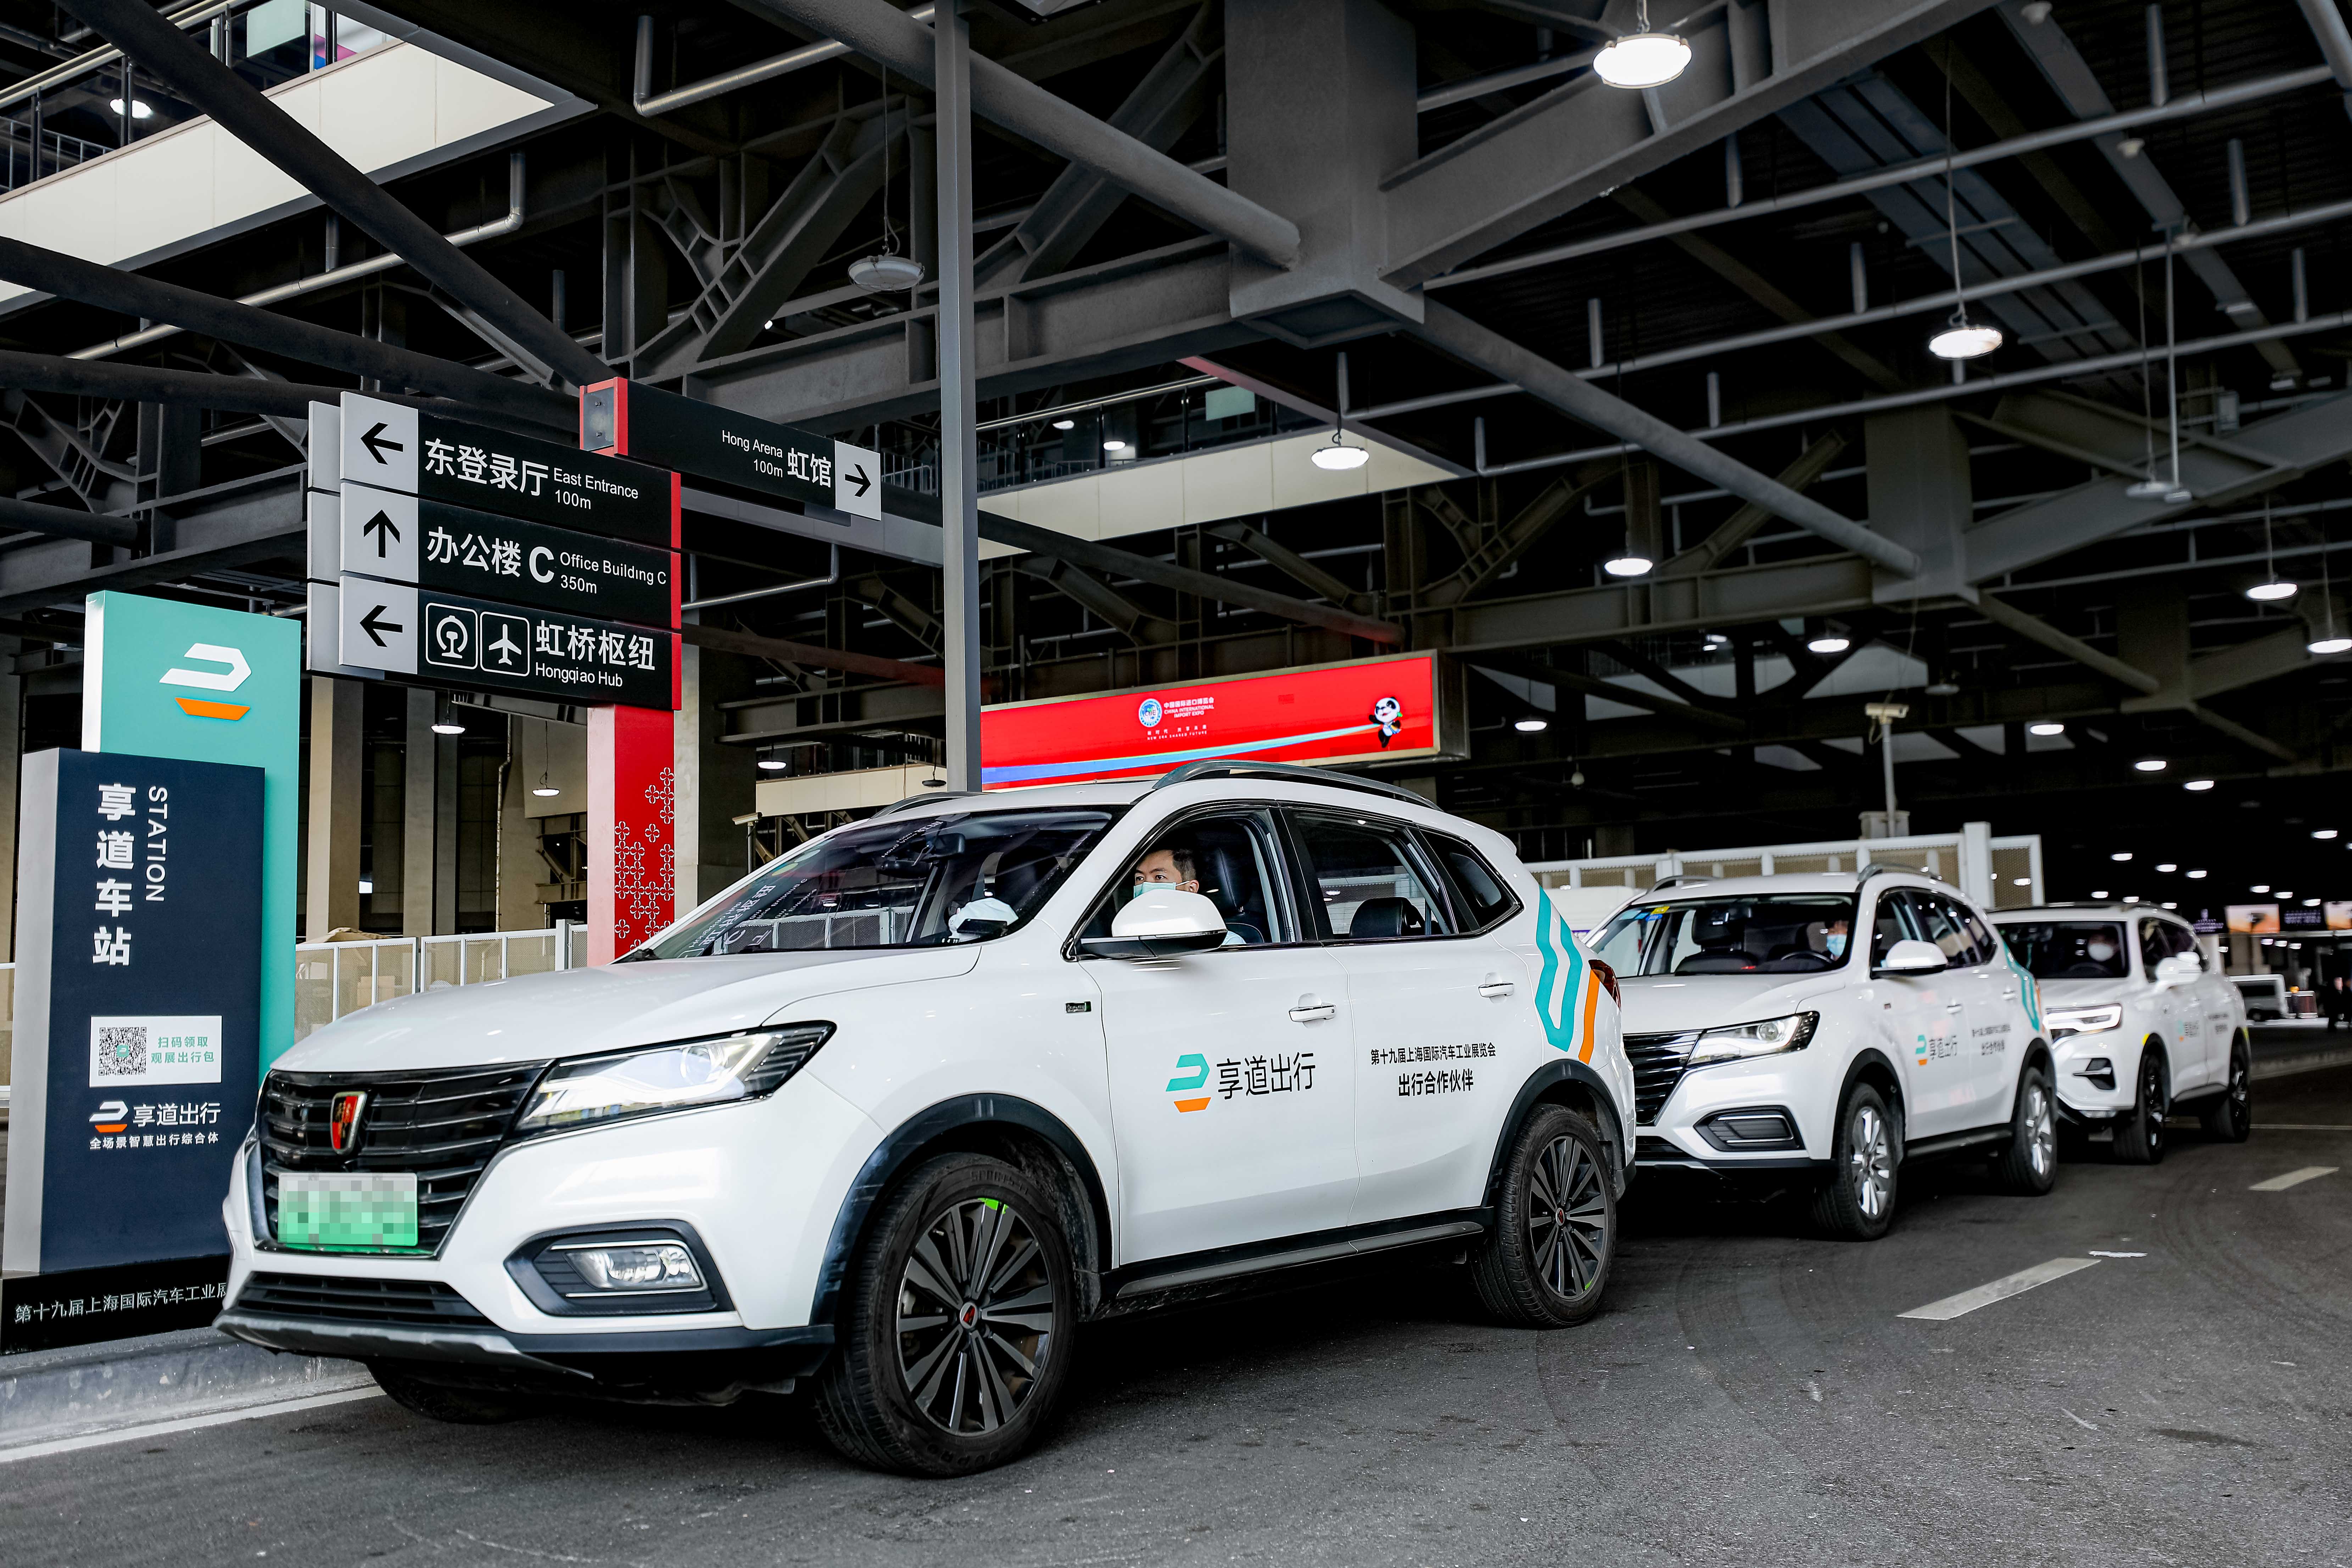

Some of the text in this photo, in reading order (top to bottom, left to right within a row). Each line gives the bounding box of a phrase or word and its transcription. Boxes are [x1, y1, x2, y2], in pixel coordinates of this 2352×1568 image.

[723, 430, 782, 458] Hong Arena
[425, 438, 548, 496] 东登录厅
[754, 459, 782, 478] 100m
[788, 448, 831, 487] 虹馆
[554, 468, 638, 499] East Entrance
[555, 490, 591, 509] 100m
[428, 526, 554, 582] 办公楼 C
[560, 552, 666, 585] Office Building C
[561, 575, 596, 593] 350m
[536, 620, 655, 670] 虹桥枢纽
[536, 662, 622, 686] Hongqiao Hub
[146, 786, 167, 901] STATION
[93, 783, 136, 965] 享道车站
[158, 1037, 207, 1048] 扫码领取
[1371, 1043, 1496, 1065] 第十九届上海国际汽车工业展览会
[151, 1051, 214, 1064] 观展出行包
[1217, 1052, 1315, 1099] 享道出行
[1399, 1068, 1473, 1096] 出行合作伙伴
[133, 1102, 220, 1127] 享道出行
[90, 1132, 218, 1149] 全场景智慧出行综合体
